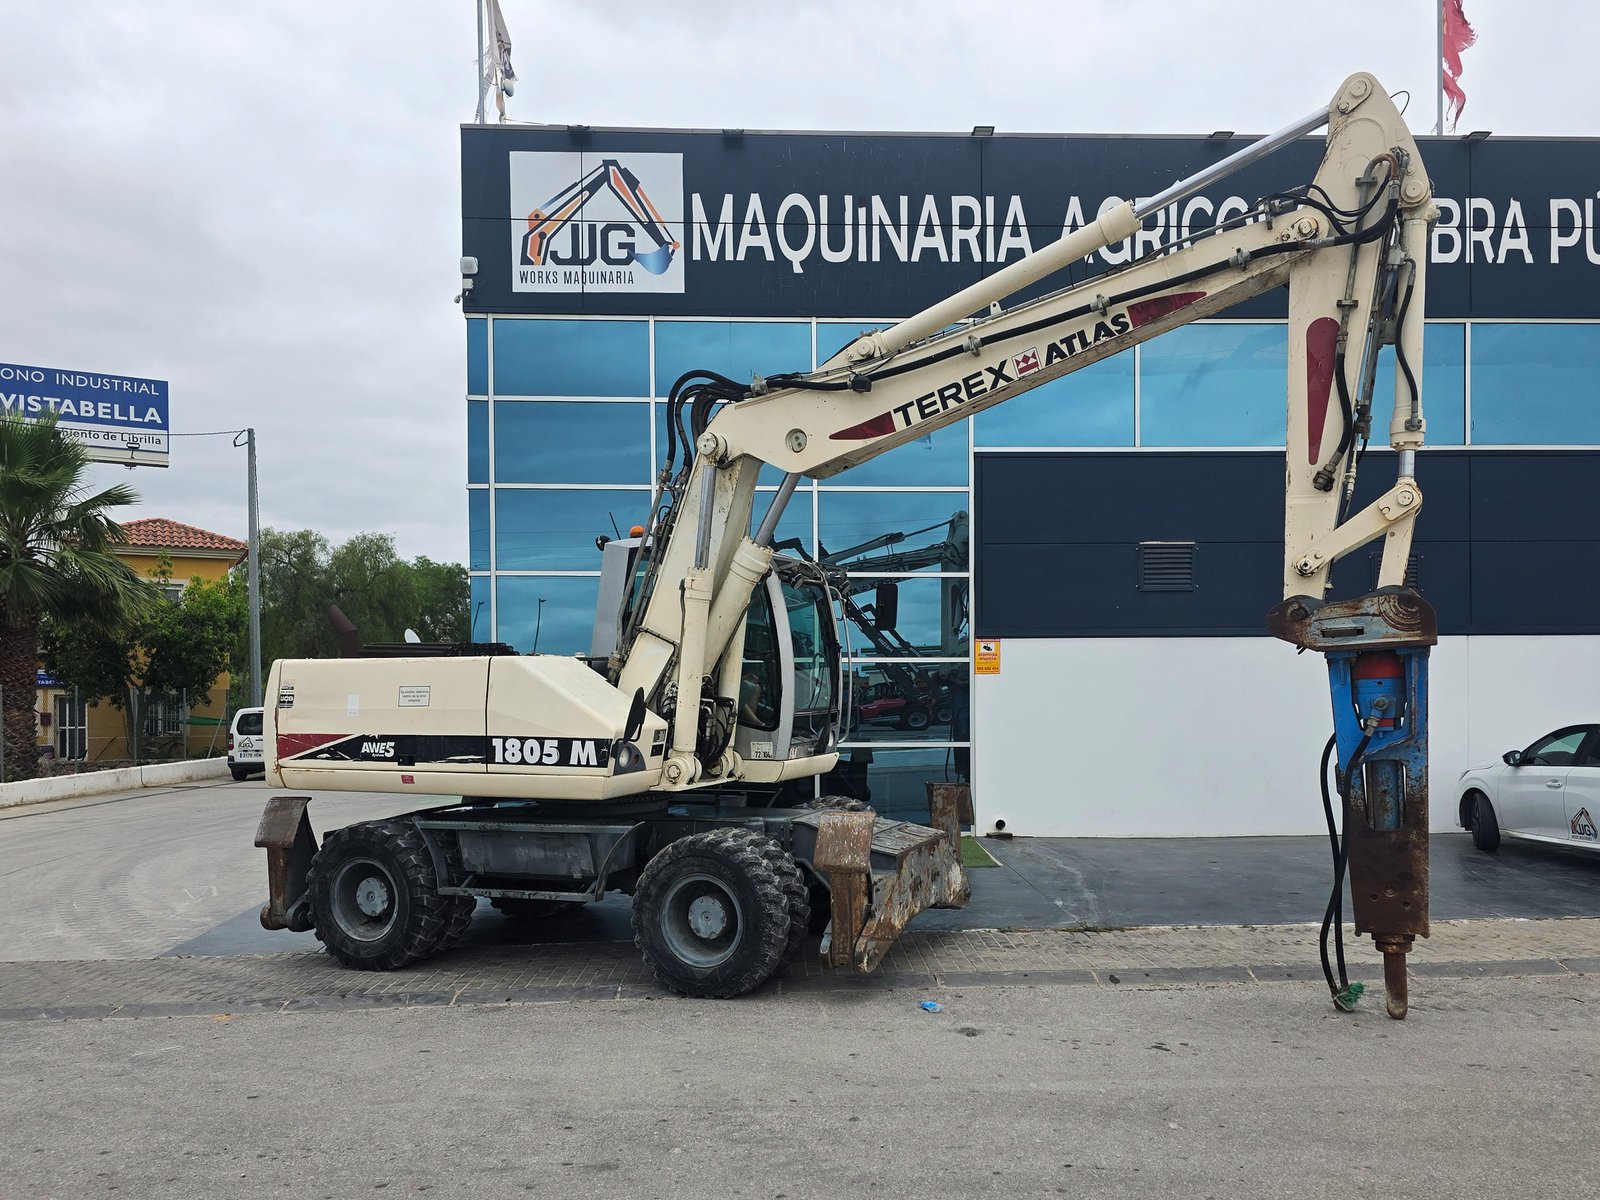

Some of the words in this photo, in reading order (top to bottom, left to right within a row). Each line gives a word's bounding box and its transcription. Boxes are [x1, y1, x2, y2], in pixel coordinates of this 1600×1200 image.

[550, 223, 636, 266] JJG
[519, 270, 558, 284] WORKS
[563, 271, 634, 285] MAQUINARIA
[893, 359, 1015, 427] TEREX
[1045, 312, 1131, 367] ATLAS
[56, 372, 160, 396] INDUSTRIAL
[0, 392, 163, 425] VISTABELLA
[103, 432, 117, 441] de
[121, 433, 162, 446] Librilla
[361, 741, 396, 758] AWE5
[492, 737, 561, 765] 1805
[569, 740, 598, 766] M
